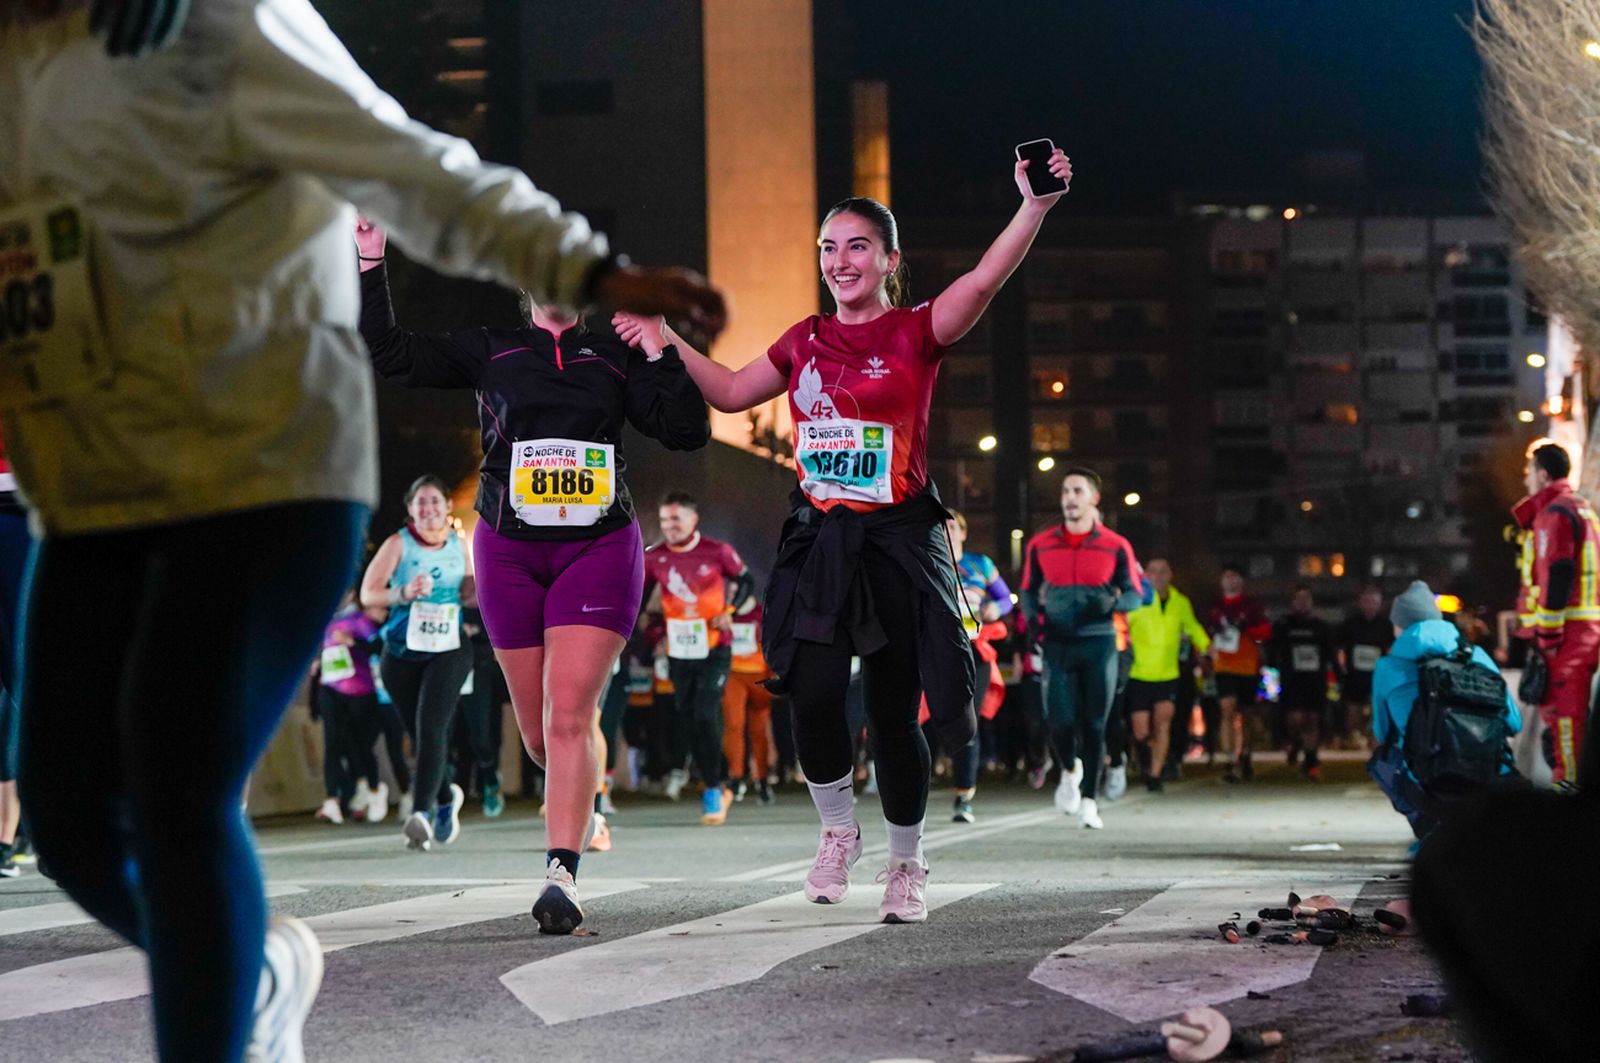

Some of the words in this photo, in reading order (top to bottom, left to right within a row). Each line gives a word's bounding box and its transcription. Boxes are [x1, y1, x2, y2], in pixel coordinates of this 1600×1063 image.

[0, 273, 53, 338] 03
[818, 429, 843, 439] NOCHE
[844, 429, 854, 438] DE
[807, 441, 827, 450] SAN
[535, 448, 563, 457] NOCHE
[566, 449, 577, 457] DE
[523, 459, 542, 467] SAN
[809, 451, 877, 478] 13610
[532, 469, 594, 495] 8186
